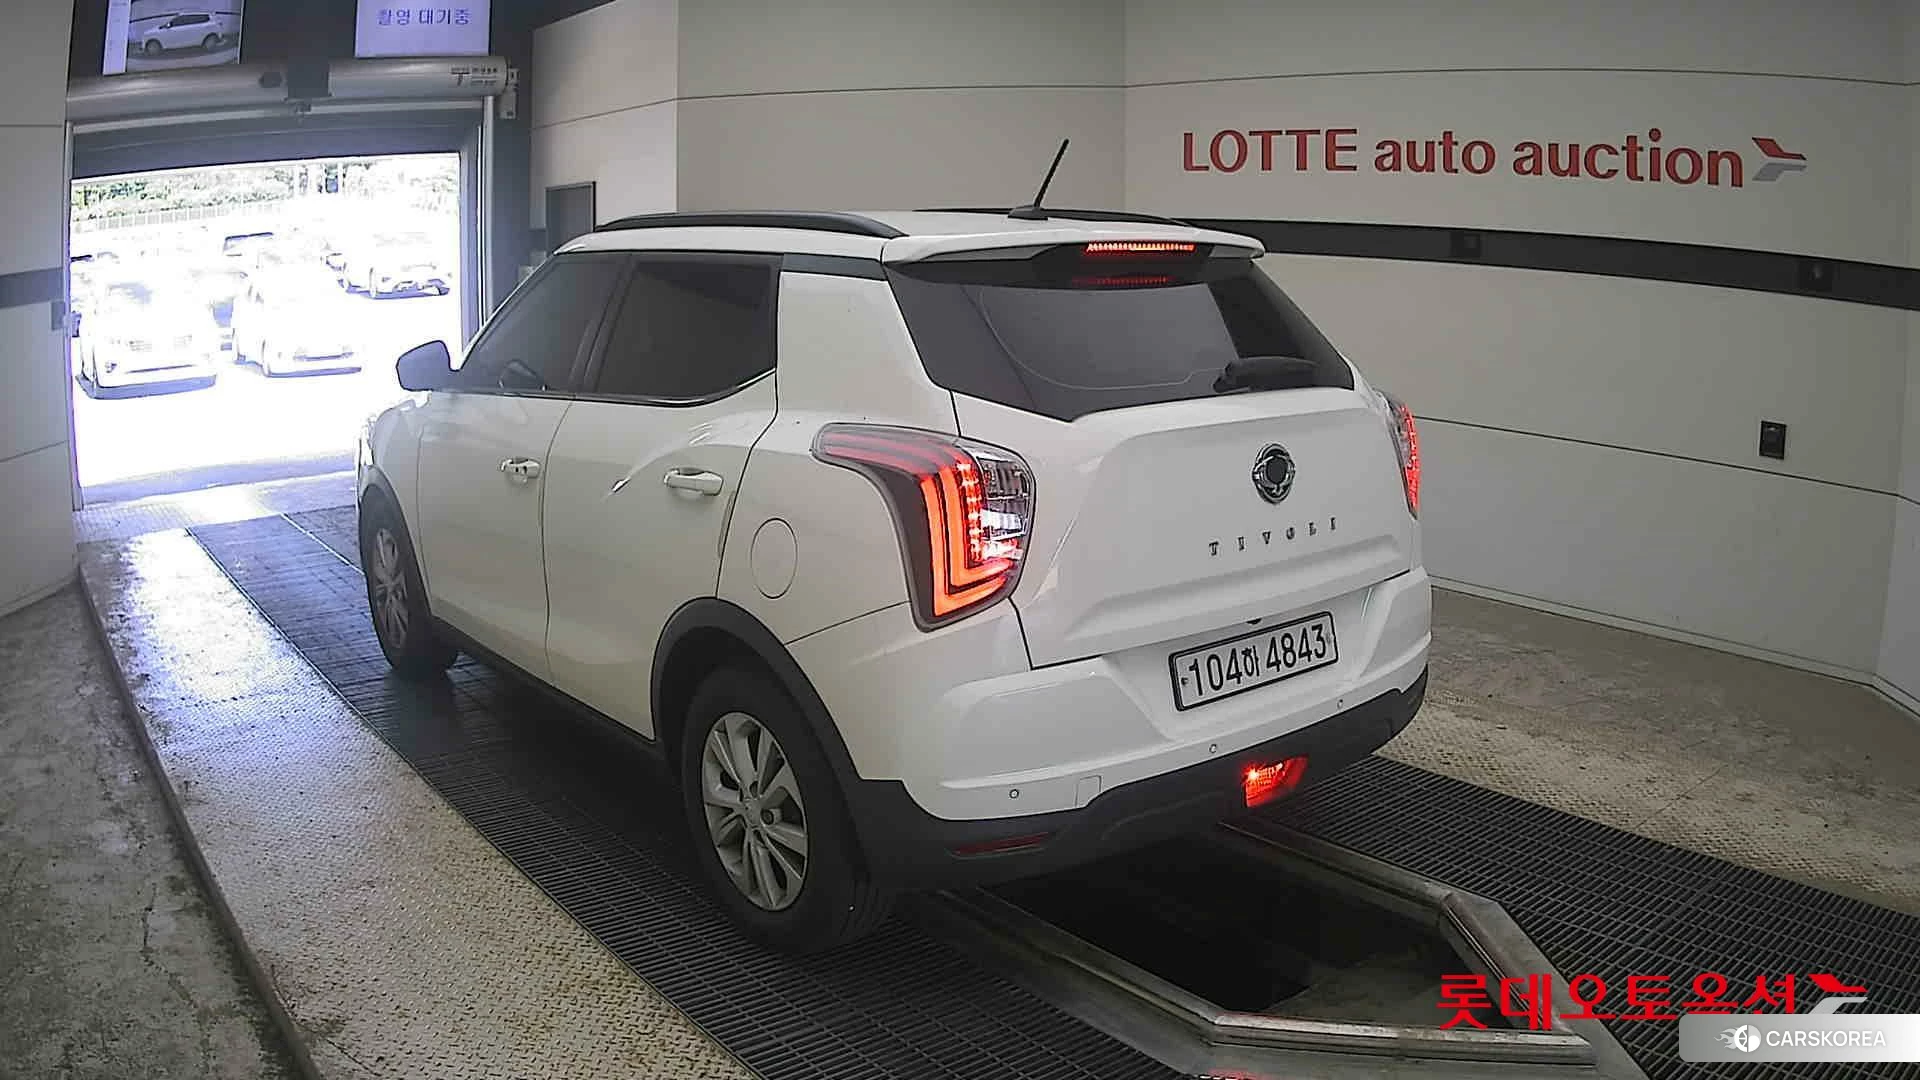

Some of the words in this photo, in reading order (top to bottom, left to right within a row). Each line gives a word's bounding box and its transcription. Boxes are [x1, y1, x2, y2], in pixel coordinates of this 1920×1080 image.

[418, 7, 471, 26] 대기중
[1183, 129, 1358, 173] LOTTE
[1375, 131, 1496, 175] auto
[1513, 128, 1744, 187] auction
[1208, 516, 1336, 556] TIVOLI
[1266, 623, 1326, 673] 4843
